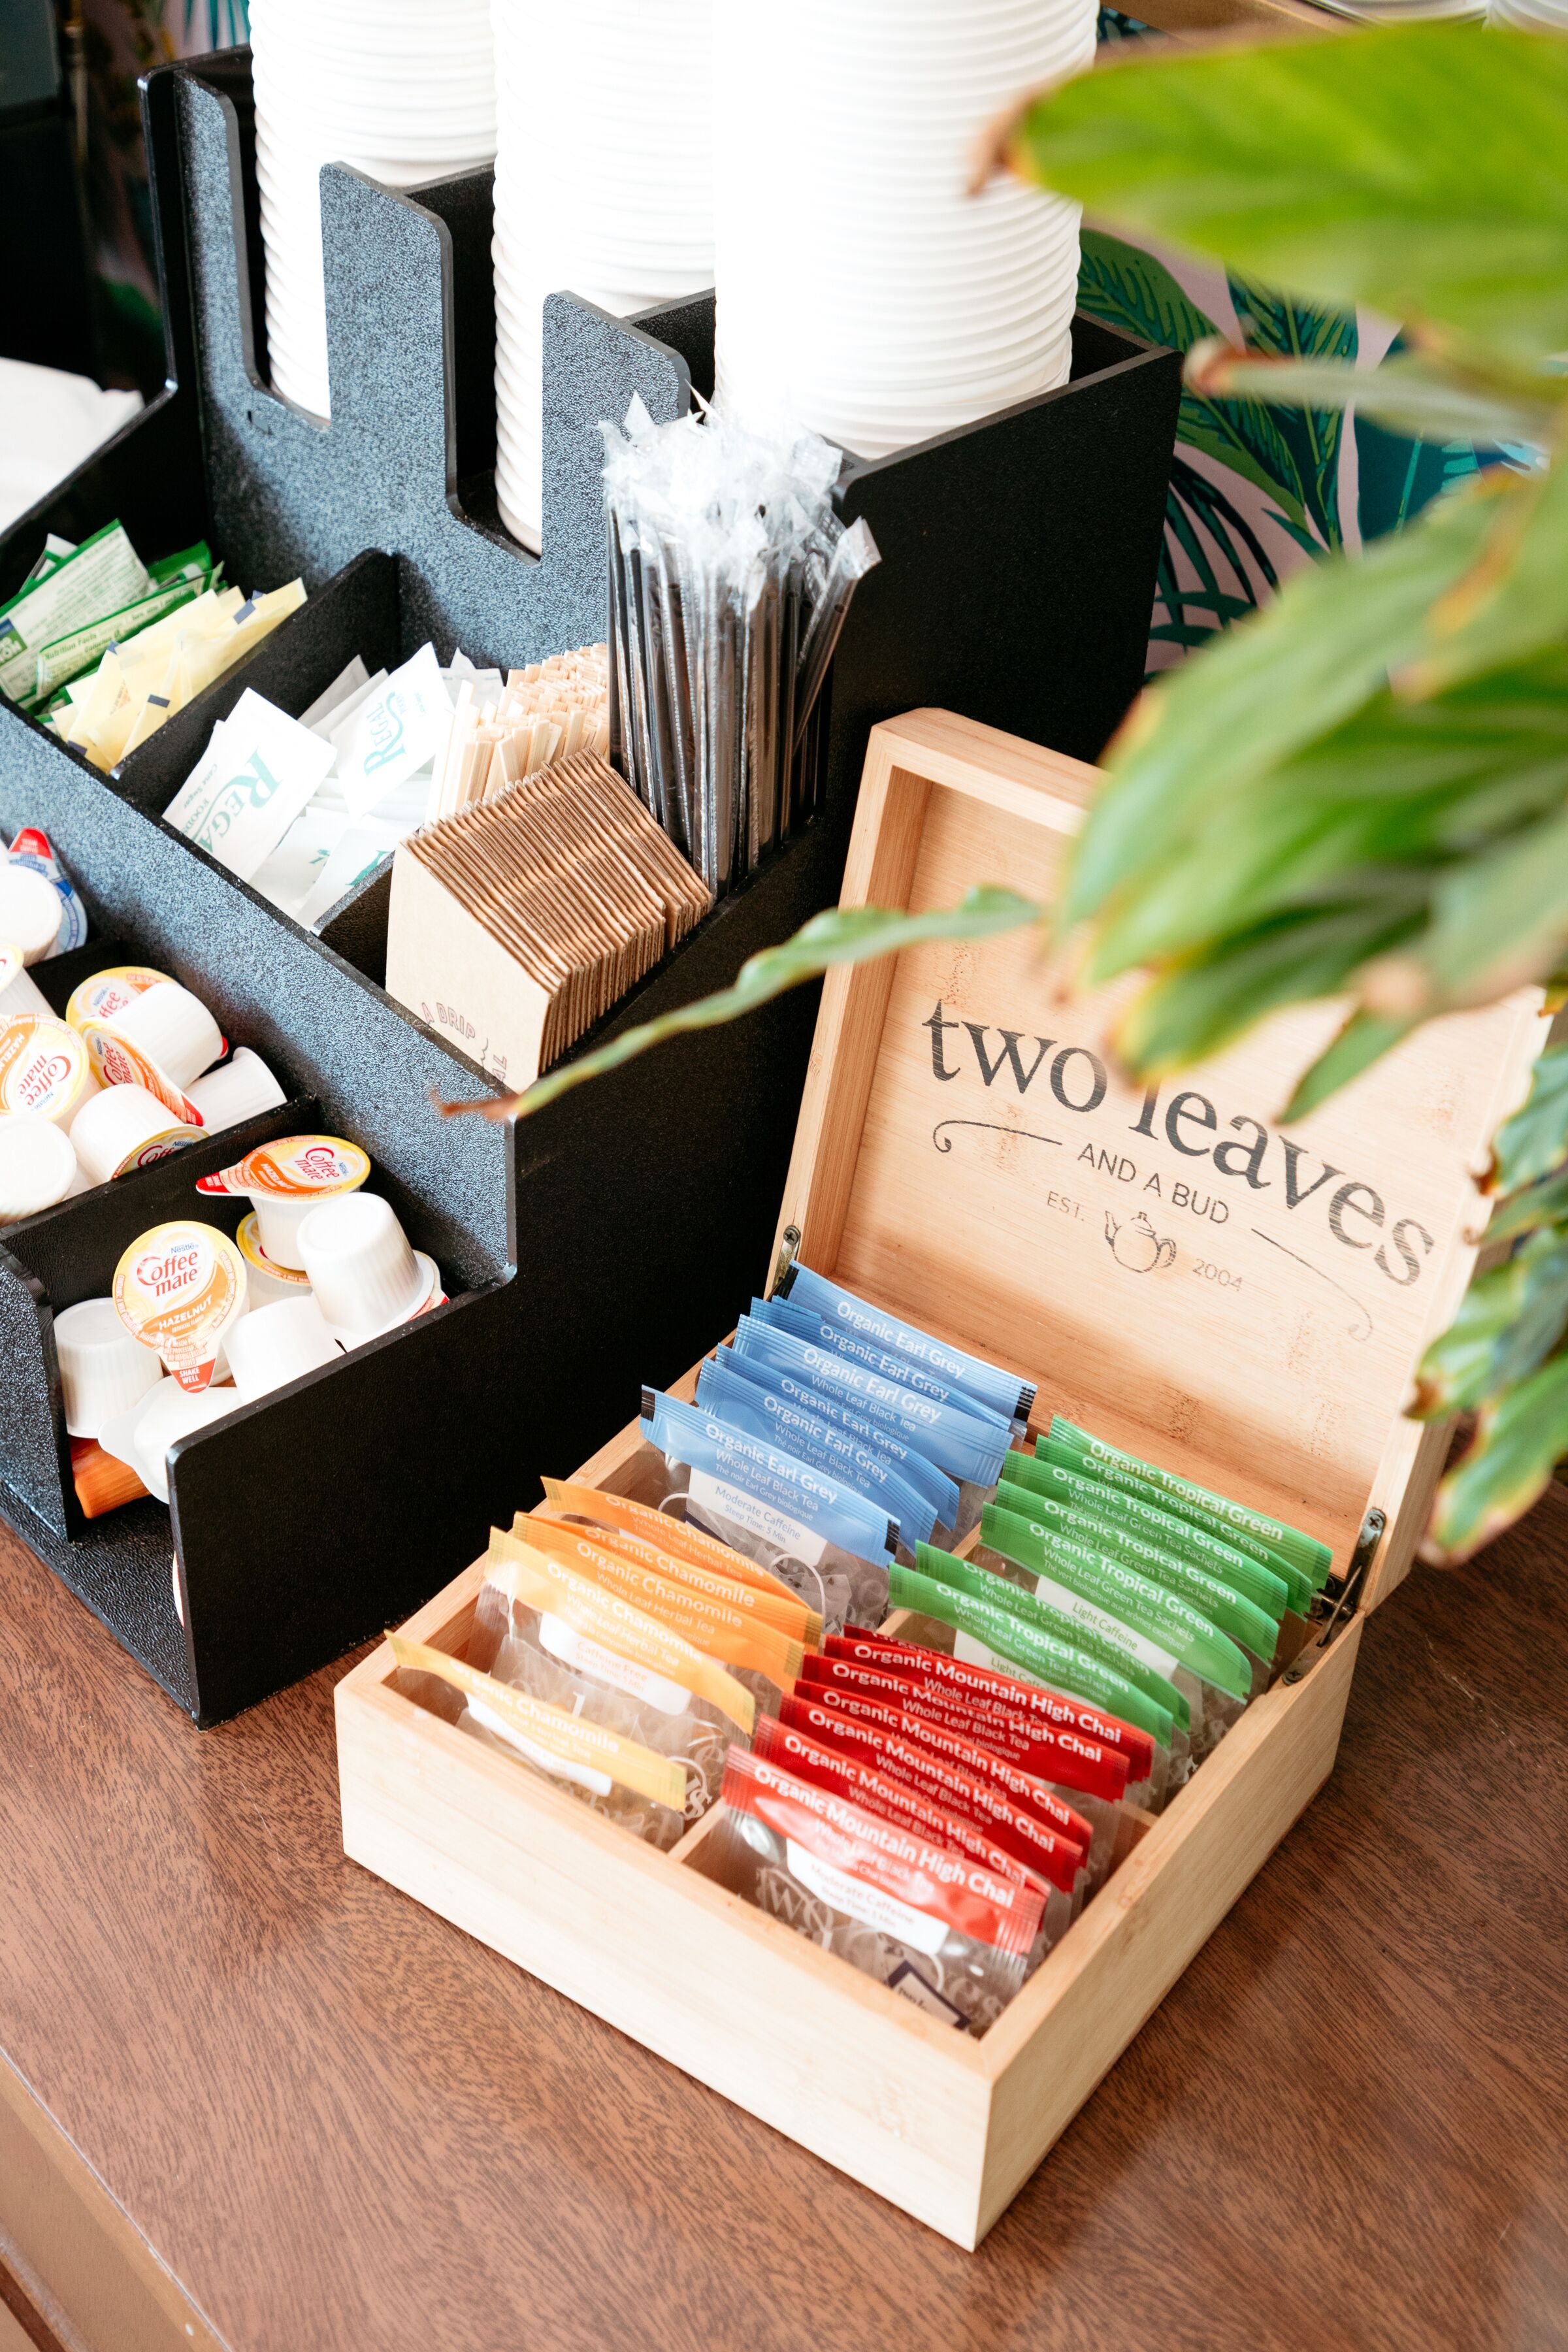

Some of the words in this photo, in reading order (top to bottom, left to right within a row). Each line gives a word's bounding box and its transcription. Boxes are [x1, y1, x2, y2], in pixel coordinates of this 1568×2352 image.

[363, 691, 408, 778] REGAL
[191, 746, 283, 853] REGA
[421, 1002, 435, 1025] A
[436, 1002, 476, 1039] DRIP
[18, 1054, 47, 1094] mate
[25, 1055, 71, 1105] Coffee
[260, 1163, 297, 1190] HAZELNUT
[295, 1159, 323, 1181] mate
[305, 1147, 340, 1179] Coffee
[921, 998, 1107, 1113] two
[1128, 1078, 1435, 1286] leaves
[1046, 1190, 1085, 1222] EST.
[1077, 1142, 1137, 1183] AND
[1143, 1173, 1162, 1198] A
[1173, 1183, 1230, 1224] BUD
[137, 1252, 198, 1286] Coffee
[155, 1267, 198, 1297] mate
[1191, 1257, 1244, 1293] 2004
[158, 1294, 213, 1330] HAZELNUT
[837, 1301, 893, 1342] Organic
[894, 1331, 926, 1358] Earl
[928, 1350, 966, 1380] Grey
[179, 1367, 200, 1377] SHAKE
[181, 1375, 200, 1384] WELL
[804, 1348, 864, 1387] Organic
[866, 1377, 899, 1403] Earl
[901, 1394, 942, 1424] Grey
[820, 1325, 877, 1364] Organic
[879, 1356, 909, 1381] Earl
[911, 1373, 949, 1402] Grey
[764, 1396, 822, 1439] Organic
[825, 1429, 853, 1458] Earl
[855, 1450, 889, 1484] Grey
[781, 1379, 838, 1418] Organic
[842, 1411, 869, 1437] Earl
[873, 1431, 908, 1460] Grey
[811, 1375, 843, 1397] Whole
[845, 1392, 868, 1409] Leaf
[869, 1402, 896, 1422] Black
[900, 1413, 916, 1431] Tea
[705, 1423, 764, 1464] Organic
[767, 1455, 797, 1482] Earl
[800, 1474, 838, 1504] Grey
[716, 1448, 749, 1474] Whole
[751, 1467, 772, 1486] Leaf
[772, 1480, 799, 1501] Black
[801, 1495, 819, 1511] Tea
[775, 1422, 805, 1447] Whole
[807, 1441, 827, 1460] Leaf
[828, 1455, 853, 1477] Black
[856, 1470, 871, 1489] Tea
[849, 1433, 873, 1454] Black
[876, 1450, 892, 1465] Tea
[715, 1486, 761, 1517] Moderate
[763, 1511, 800, 1541] Caffeine
[725, 1504, 745, 1521] Steep
[745, 1516, 764, 1531] Time:
[773, 1529, 787, 1543] Min
[730, 1471, 745, 1482] noir
[745, 1478, 759, 1491] Earl
[759, 1488, 776, 1501] Grey
[777, 1495, 813, 1521] biologique
[1053, 1467, 1120, 1504] Organic
[1121, 1496, 1189, 1539] Tropical
[1192, 1531, 1244, 1568] Green
[1083, 1456, 1148, 1494] Organic
[1152, 1489, 1217, 1528] Tropical
[1220, 1523, 1269, 1561] Green
[1090, 1440, 1156, 1480] Organic
[1160, 1471, 1226, 1516] Tropical
[1228, 1506, 1284, 1541] Green
[585, 1529, 654, 1563] Organic
[655, 1555, 756, 1607] Chamomile
[606, 1495, 674, 1529] Organic
[675, 1523, 764, 1577] Chamomile
[1044, 1501, 1112, 1539] Organic
[1115, 1530, 1182, 1573] Tropical
[1185, 1567, 1237, 1605] Green
[1068, 1488, 1103, 1512] Whole
[1105, 1505, 1129, 1524] Leaf
[1130, 1517, 1163, 1541] Green
[1164, 1533, 1182, 1551] Tea
[1183, 1544, 1224, 1575] Sachets
[547, 1562, 610, 1610] Organic
[612, 1601, 704, 1665] Chamomile
[577, 1542, 640, 1587] Organic
[642, 1576, 743, 1628] Chamomile
[596, 1571, 629, 1597] Whole
[629, 1593, 653, 1610] Leaf
[653, 1604, 693, 1627] Herbal
[696, 1620, 716, 1635] Tea
[1029, 1523, 1096, 1565] Organic
[1100, 1555, 1164, 1605] Tropical
[1165, 1596, 1214, 1637] Green
[1043, 1546, 1077, 1573] Whole
[1078, 1566, 1101, 1585] Leaf
[1102, 1581, 1134, 1606] Green
[1135, 1600, 1153, 1617] Tea
[1154, 1610, 1196, 1643] Sachets
[1073, 1576, 1110, 1605] biologique
[936, 1583, 1004, 1624] Organic
[1007, 1613, 1075, 1661] Tropical
[1077, 1653, 1130, 1693] Green
[1072, 1602, 1098, 1625] Light
[1098, 1617, 1138, 1651] Caffeine
[854, 1644, 932, 1672] Organic
[935, 1661, 1027, 1706] Mountain
[1030, 1693, 1075, 1724] High
[1078, 1714, 1122, 1743] Chai
[990, 1657, 1017, 1680] Light
[832, 1663, 909, 1694] Organic
[912, 1687, 1005, 1728] Mountain
[1008, 1718, 1054, 1744] High
[1058, 1733, 1102, 1763] Chai
[902, 1698, 943, 1722] Whole
[944, 1713, 971, 1731] Leaf
[972, 1723, 1005, 1742] Black
[1009, 1733, 1030, 1751] Tea
[808, 1709, 883, 1750] Organic
[885, 1739, 970, 1797] Mountain
[973, 1788, 1013, 1825] High
[1015, 1816, 1055, 1853] Chai
[823, 1691, 898, 1727] Organic
[901, 1716, 988, 1772] Mountain
[990, 1761, 1030, 1797] High
[1032, 1789, 1070, 1825] Chai
[754, 1765, 825, 1814] Organic
[826, 1802, 917, 1863] Mountain
[919, 1846, 966, 1886] High
[968, 1869, 1016, 1908] Chai
[785, 1735, 857, 1782] Organic
[858, 1771, 943, 1830] Mountain
[946, 1821, 987, 1858] High
[988, 1850, 1026, 1888] Chai
